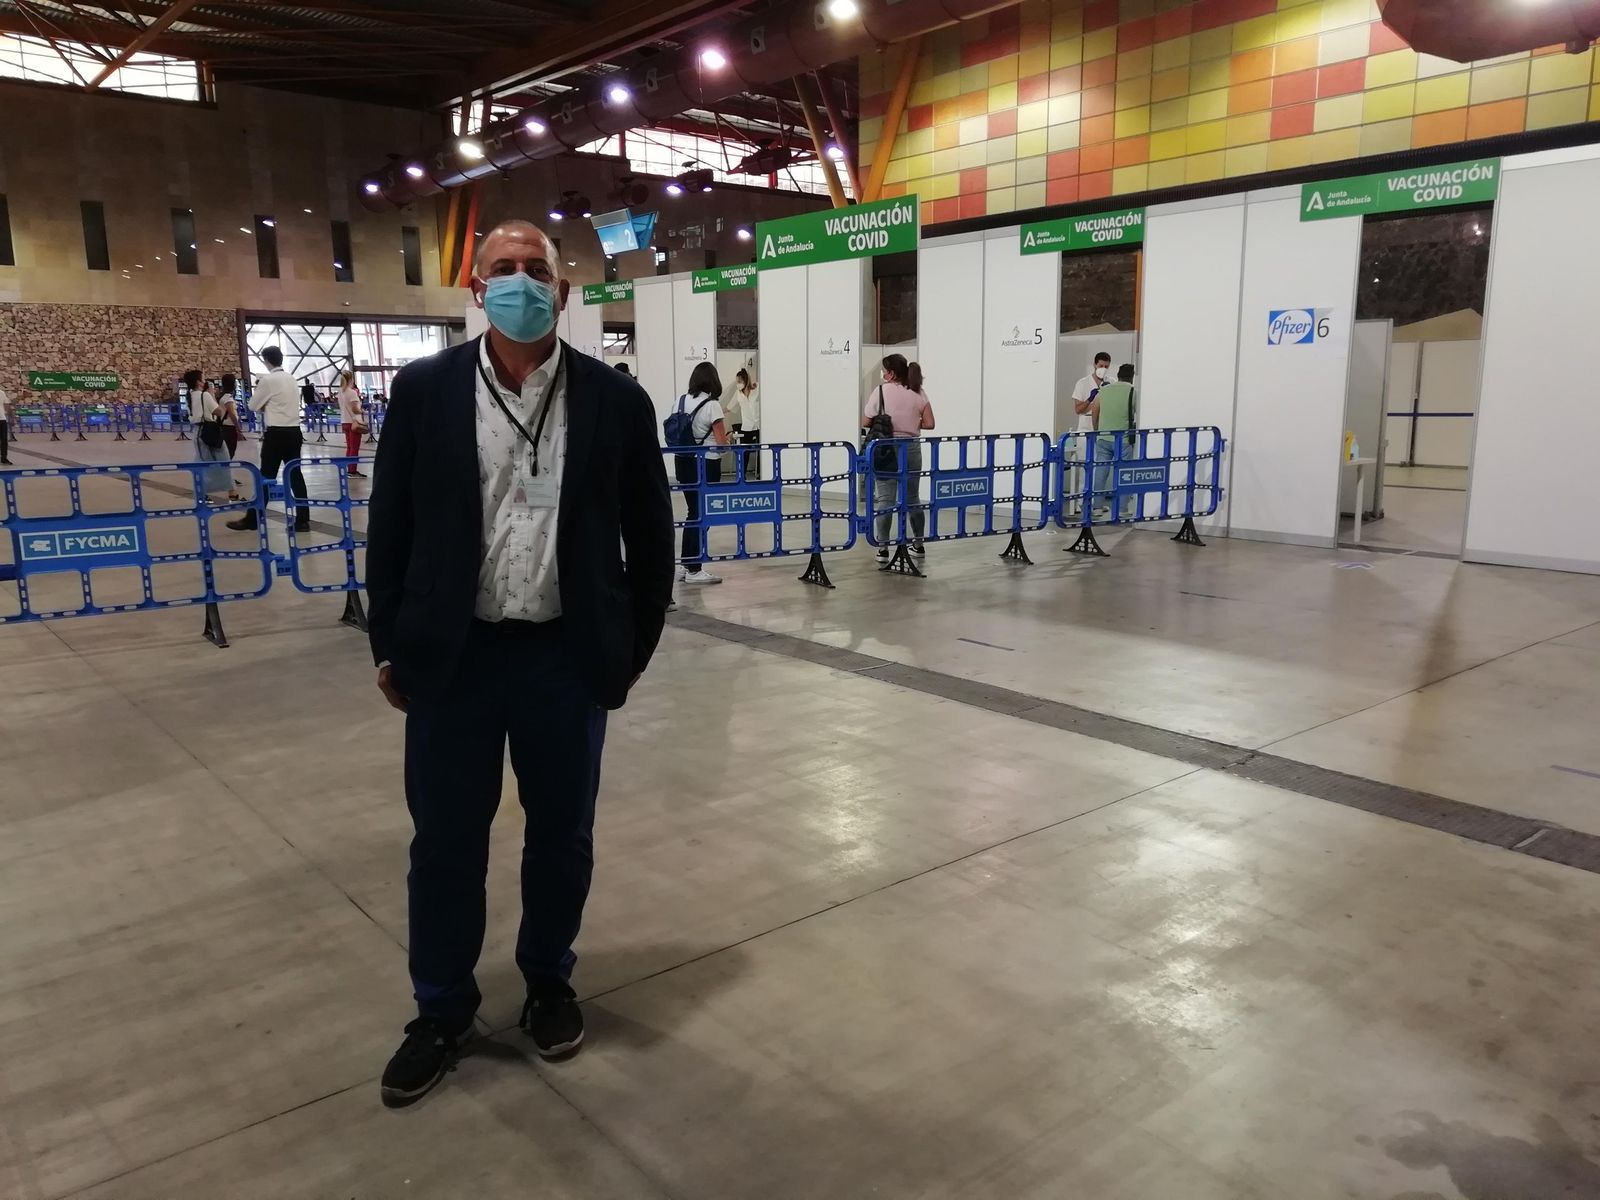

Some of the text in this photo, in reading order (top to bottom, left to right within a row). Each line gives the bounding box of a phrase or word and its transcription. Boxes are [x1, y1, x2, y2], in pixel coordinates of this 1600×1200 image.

[1387, 164, 1494, 191] VACUNACIÓN
[1328, 190, 1347, 199] Junta
[1413, 185, 1463, 203] COVID
[1327, 195, 1371, 208] de Andalucía
[824, 202, 913, 236] VACUNACIÓN
[1075, 212, 1141, 232] VACUNACIÓN
[778, 234, 794, 244] Junta
[848, 230, 889, 252] COVID
[1092, 228, 1123, 242] COVID
[778, 240, 814, 254] de Andalucía
[721, 266, 756, 278] VACUNACIÓN
[605, 281, 632, 293] VACUNACIÓN
[730, 276, 747, 286] COVID
[612, 290, 626, 300] COVID
[1272, 316, 1330, 344] Pfizer 6
[1001, 328, 1043, 347] AstraZeneca 5
[593, 347, 597, 357] 2
[703, 347, 708, 360] 3
[844, 340, 850, 354] 4
[748, 358, 753, 367] 4
[1135, 470, 1162, 480] FYCMA
[955, 482, 985, 493] FYCMA
[732, 496, 771, 508] FYCMA
[64, 534, 130, 550] FYCMA
